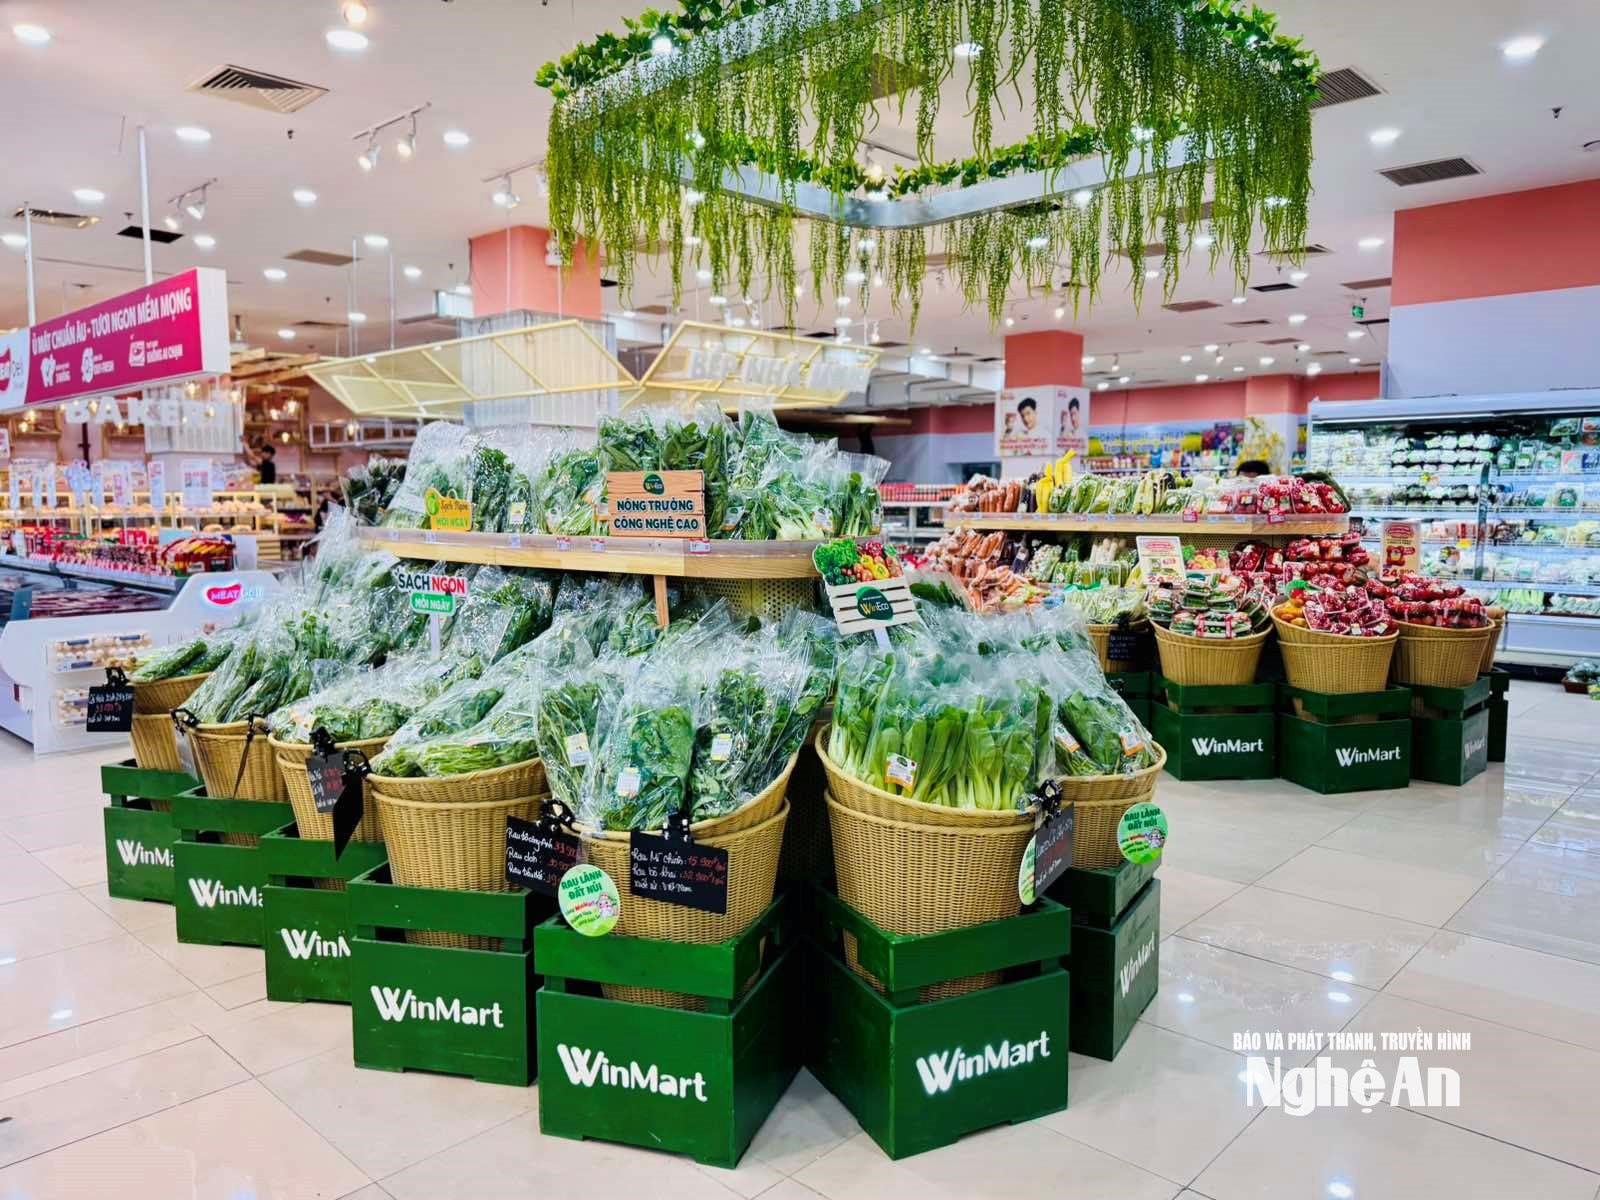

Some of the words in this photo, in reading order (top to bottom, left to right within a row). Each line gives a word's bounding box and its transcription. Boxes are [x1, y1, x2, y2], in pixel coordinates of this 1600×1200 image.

[111, 306, 136, 333] NGON
[160, 287, 192, 322] MỌNG
[617, 497, 646, 511] NÔNG
[647, 496, 694, 511] TRƯỜNG
[613, 515, 643, 529] CÔNG
[645, 515, 674, 533] NGHỆ
[676, 519, 699, 530] CAO
[431, 576, 465, 594] NGON
[1192, 736, 1264, 756] WinMart
[1335, 746, 1401, 767] WinMart
[1124, 813, 1139, 822] RAU
[561, 878, 579, 890] RAU
[580, 869, 602, 884] LÀNH
[568, 886, 585, 900] ĐẤT
[587, 881, 603, 894] NÚI
[1120, 931, 1155, 998] WinMart
[371, 985, 504, 1029] WinMart
[556, 1043, 708, 1102] WinMart
[916, 1030, 1051, 1095] WinMart
